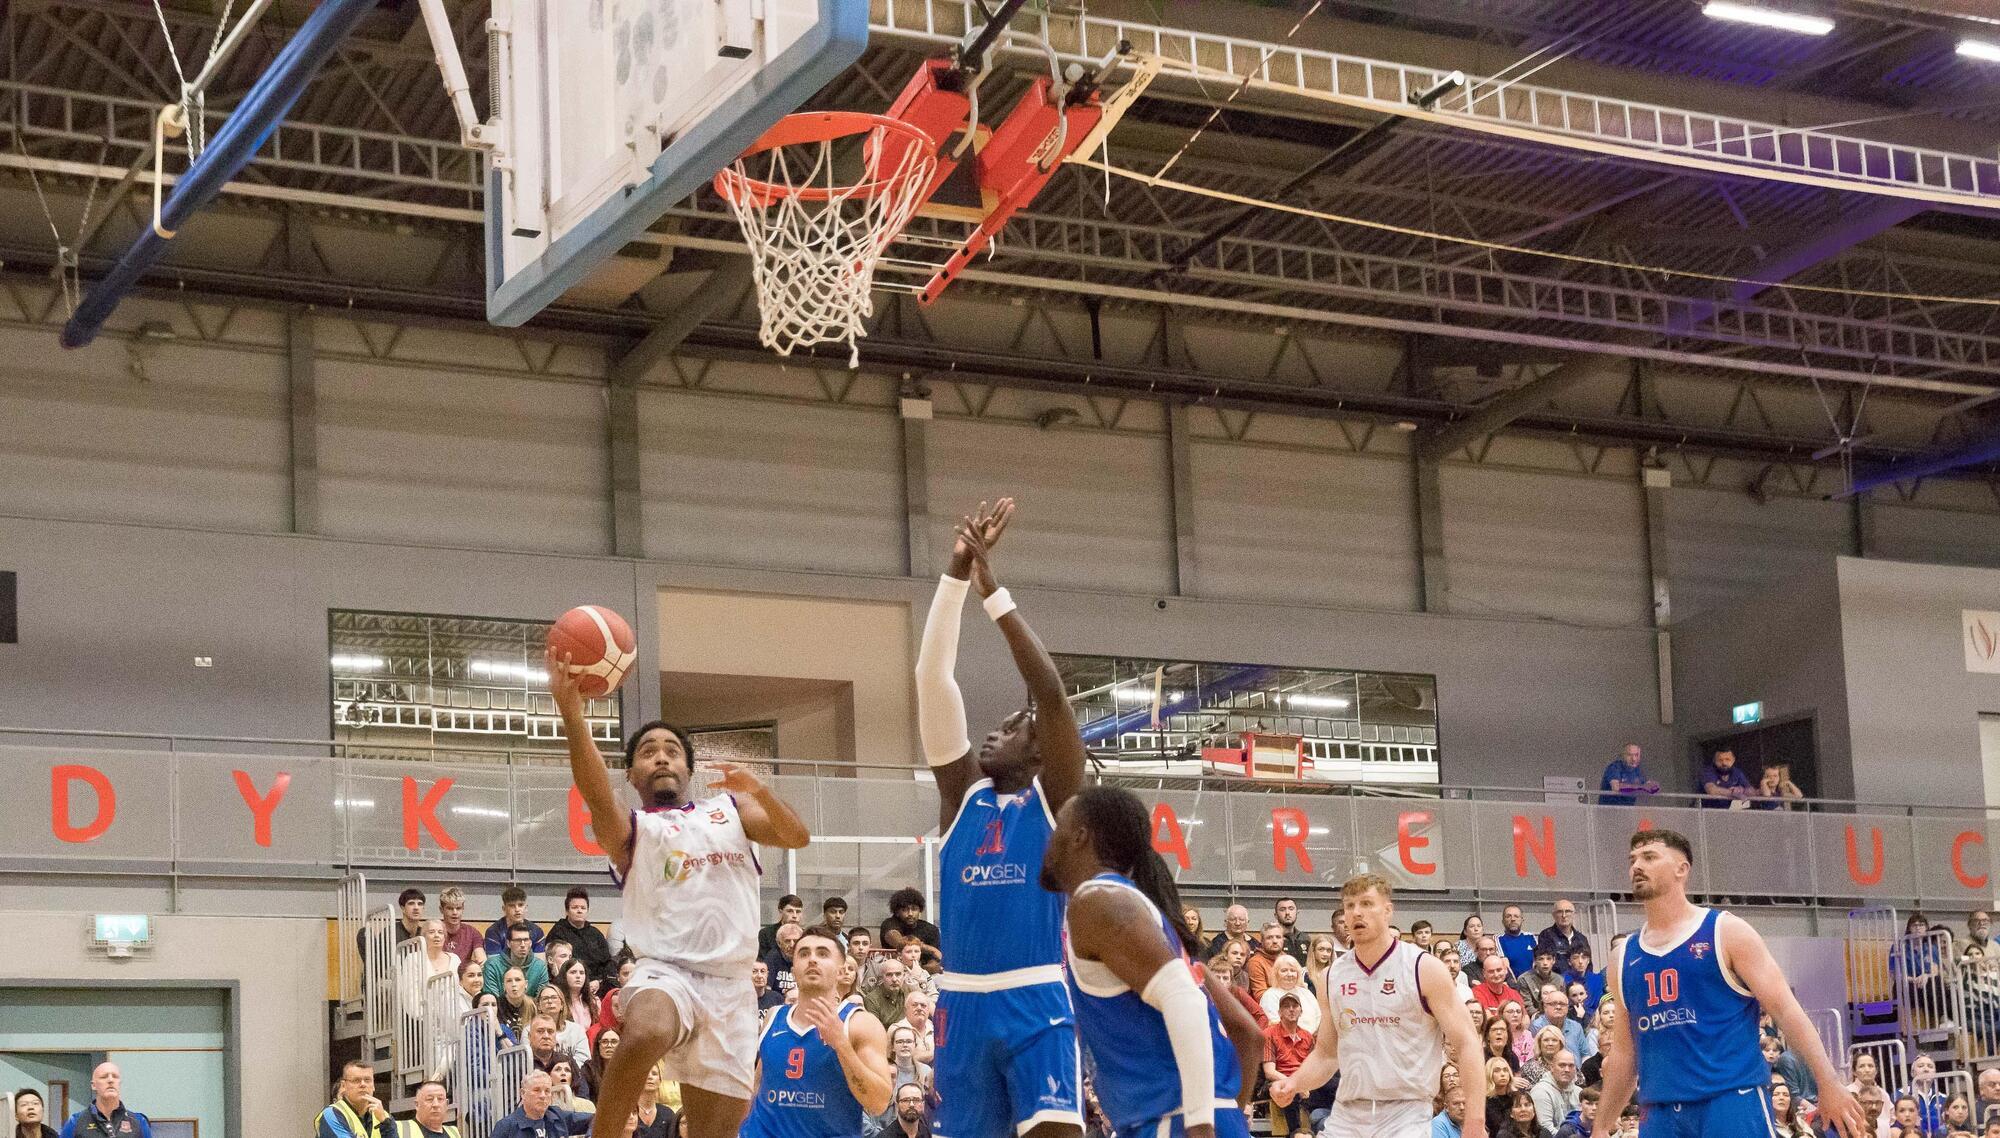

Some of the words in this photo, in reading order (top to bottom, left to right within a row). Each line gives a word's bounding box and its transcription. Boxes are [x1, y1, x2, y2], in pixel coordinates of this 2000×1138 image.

[1340, 983, 1357, 995] 15
[1644, 968, 1678, 1007] 10
[1651, 1008, 1696, 1026] PVGEN
[785, 1047, 805, 1079] 9
[778, 1090, 825, 1105] PVGEN
